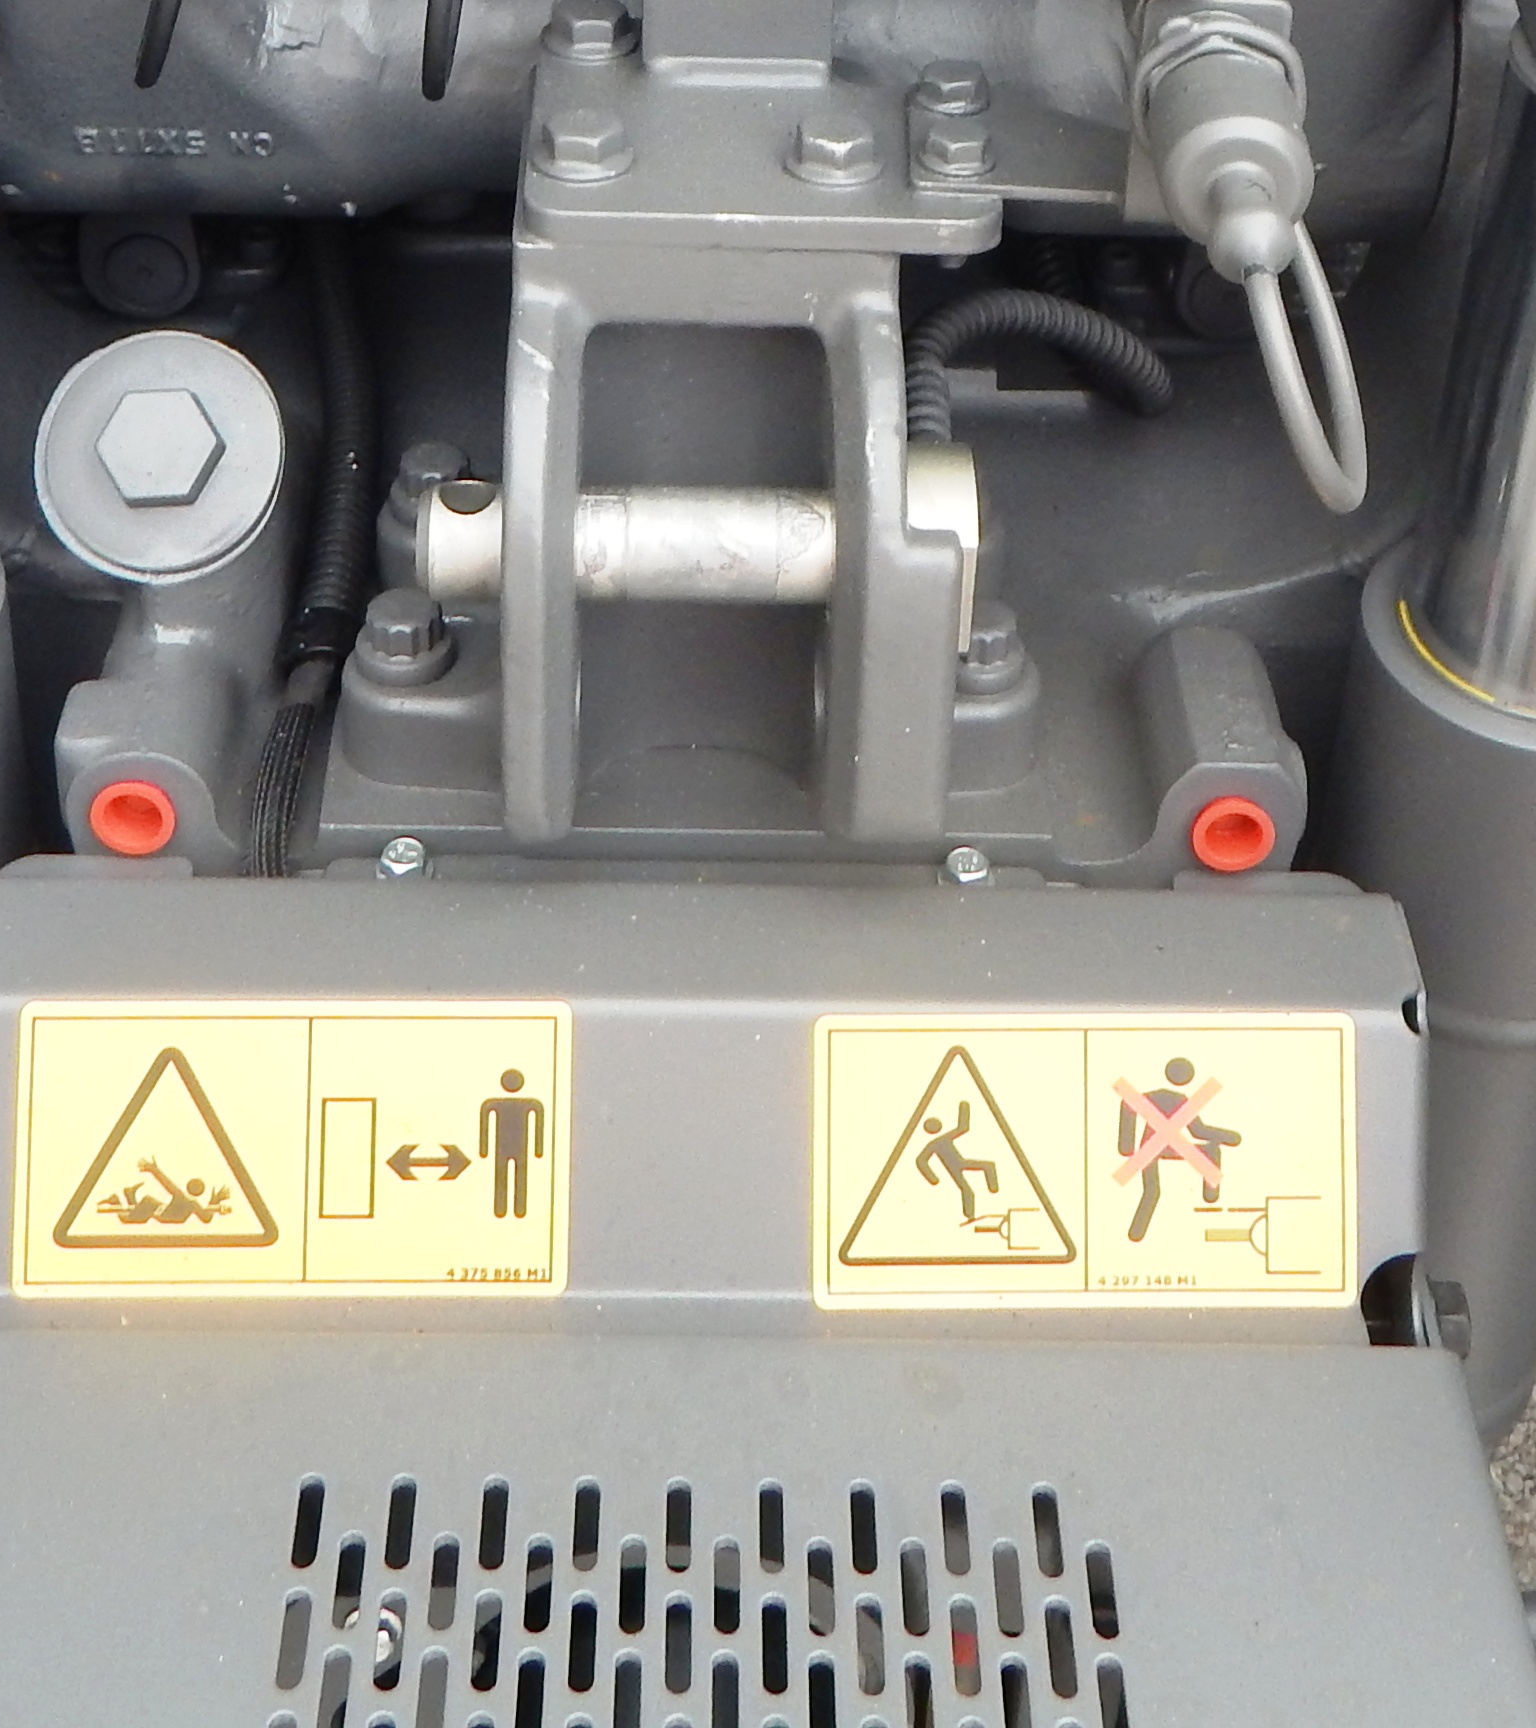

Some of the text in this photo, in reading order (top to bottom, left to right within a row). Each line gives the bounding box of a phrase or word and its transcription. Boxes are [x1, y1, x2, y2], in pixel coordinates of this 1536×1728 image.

[446, 1267, 455, 1280] 4
[527, 1267, 546, 1280] M1
[1098, 1275, 1107, 1286] 4
[1177, 1275, 1197, 1286] M1
